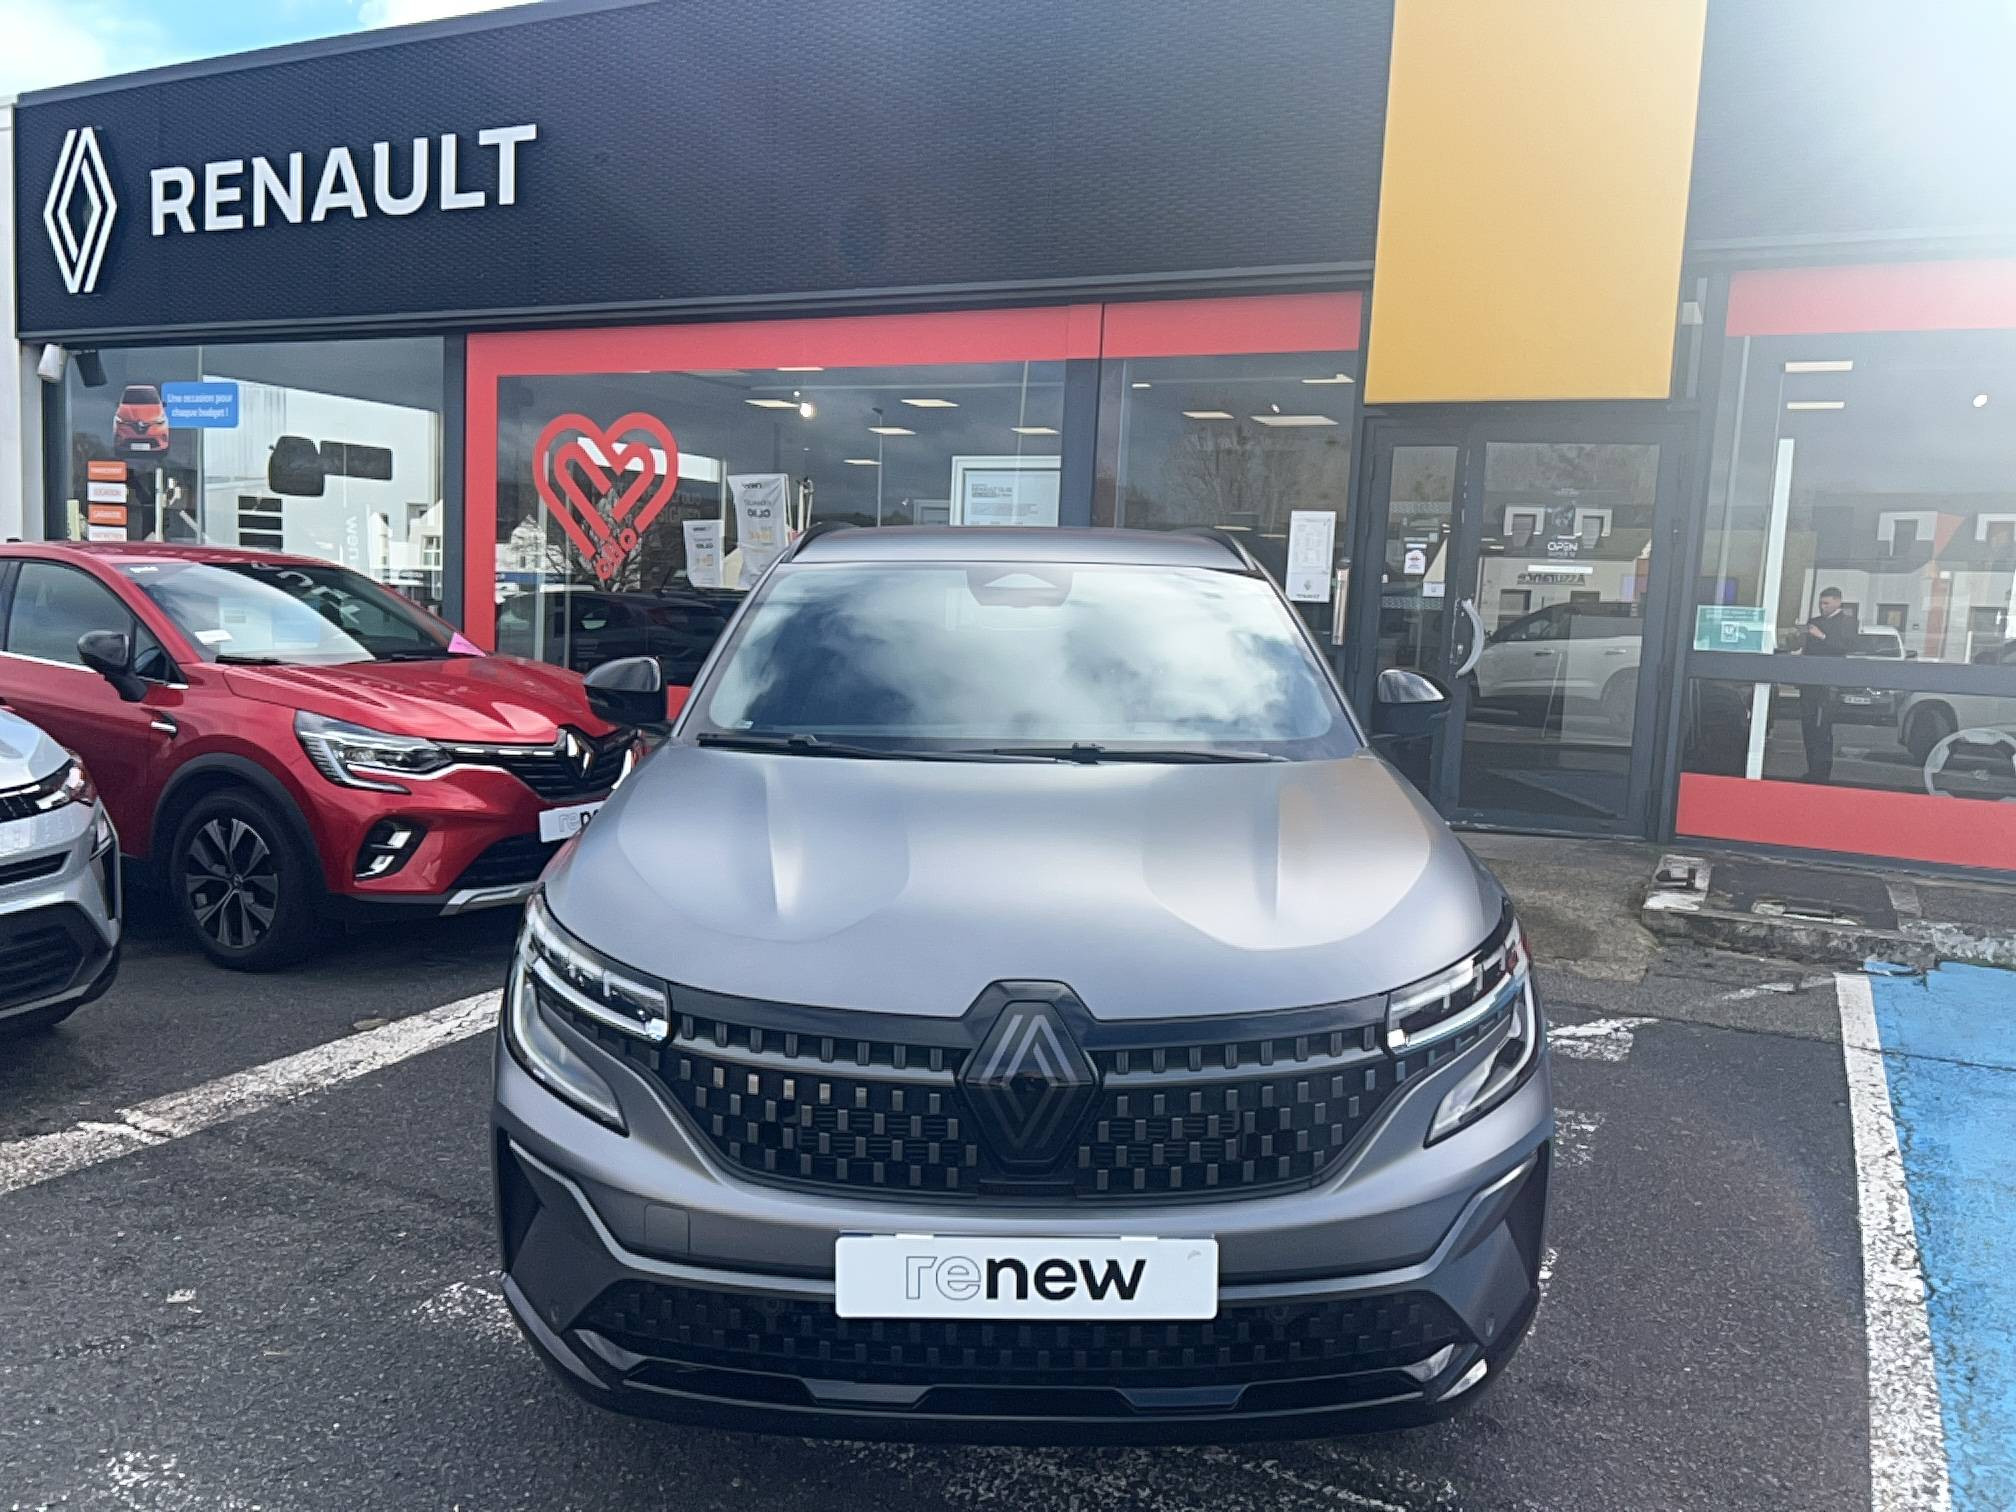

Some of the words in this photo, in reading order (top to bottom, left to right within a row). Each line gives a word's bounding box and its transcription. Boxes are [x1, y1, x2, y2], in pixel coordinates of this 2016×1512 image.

[150, 124, 538, 236] RENAULT
[183, 394, 214, 403] occasion
[215, 394, 233, 405] pour
[198, 407, 225, 419] budget
[905, 1255, 1147, 1301] renew
